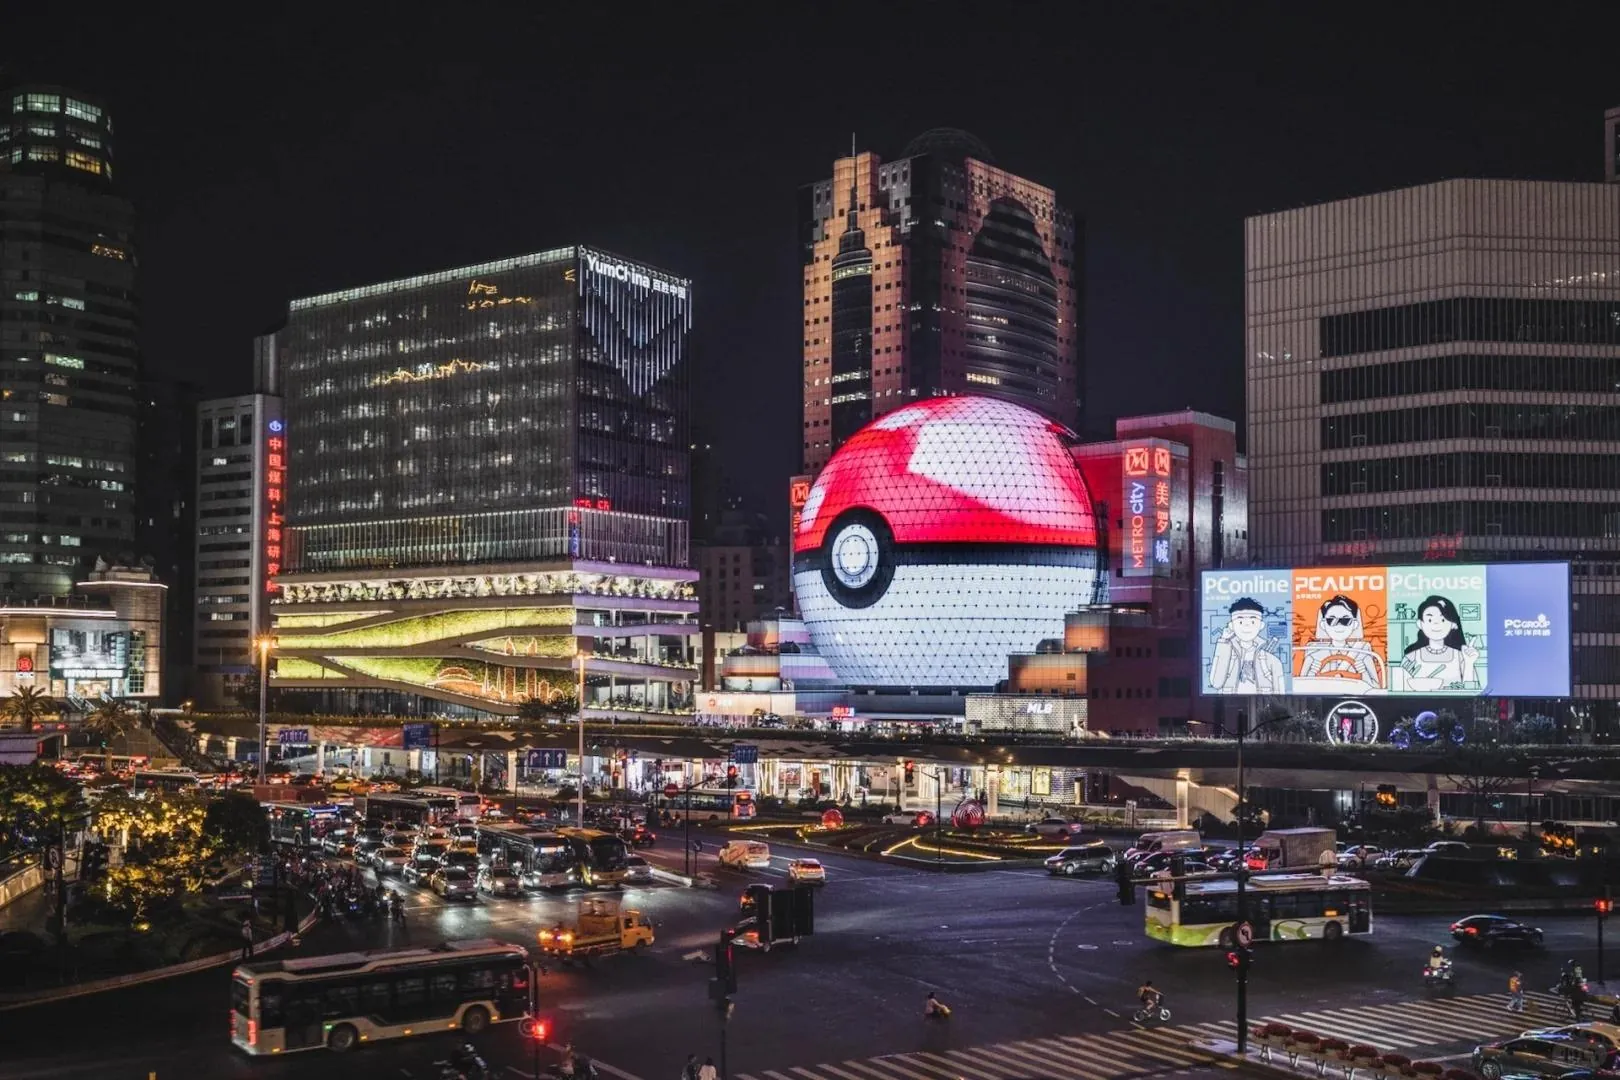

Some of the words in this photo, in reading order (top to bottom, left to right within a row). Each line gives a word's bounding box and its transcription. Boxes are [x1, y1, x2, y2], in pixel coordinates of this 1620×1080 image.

[586, 253, 651, 290] YumChina
[652, 278, 686, 300] 百胜中国
[1155, 482, 1169, 563] 美罗城
[1205, 575, 1289, 594] PConline
[1295, 575, 1385, 592] PCAUTO
[1389, 572, 1482, 592] PChouse
[1026, 702, 1053, 714] MLB
